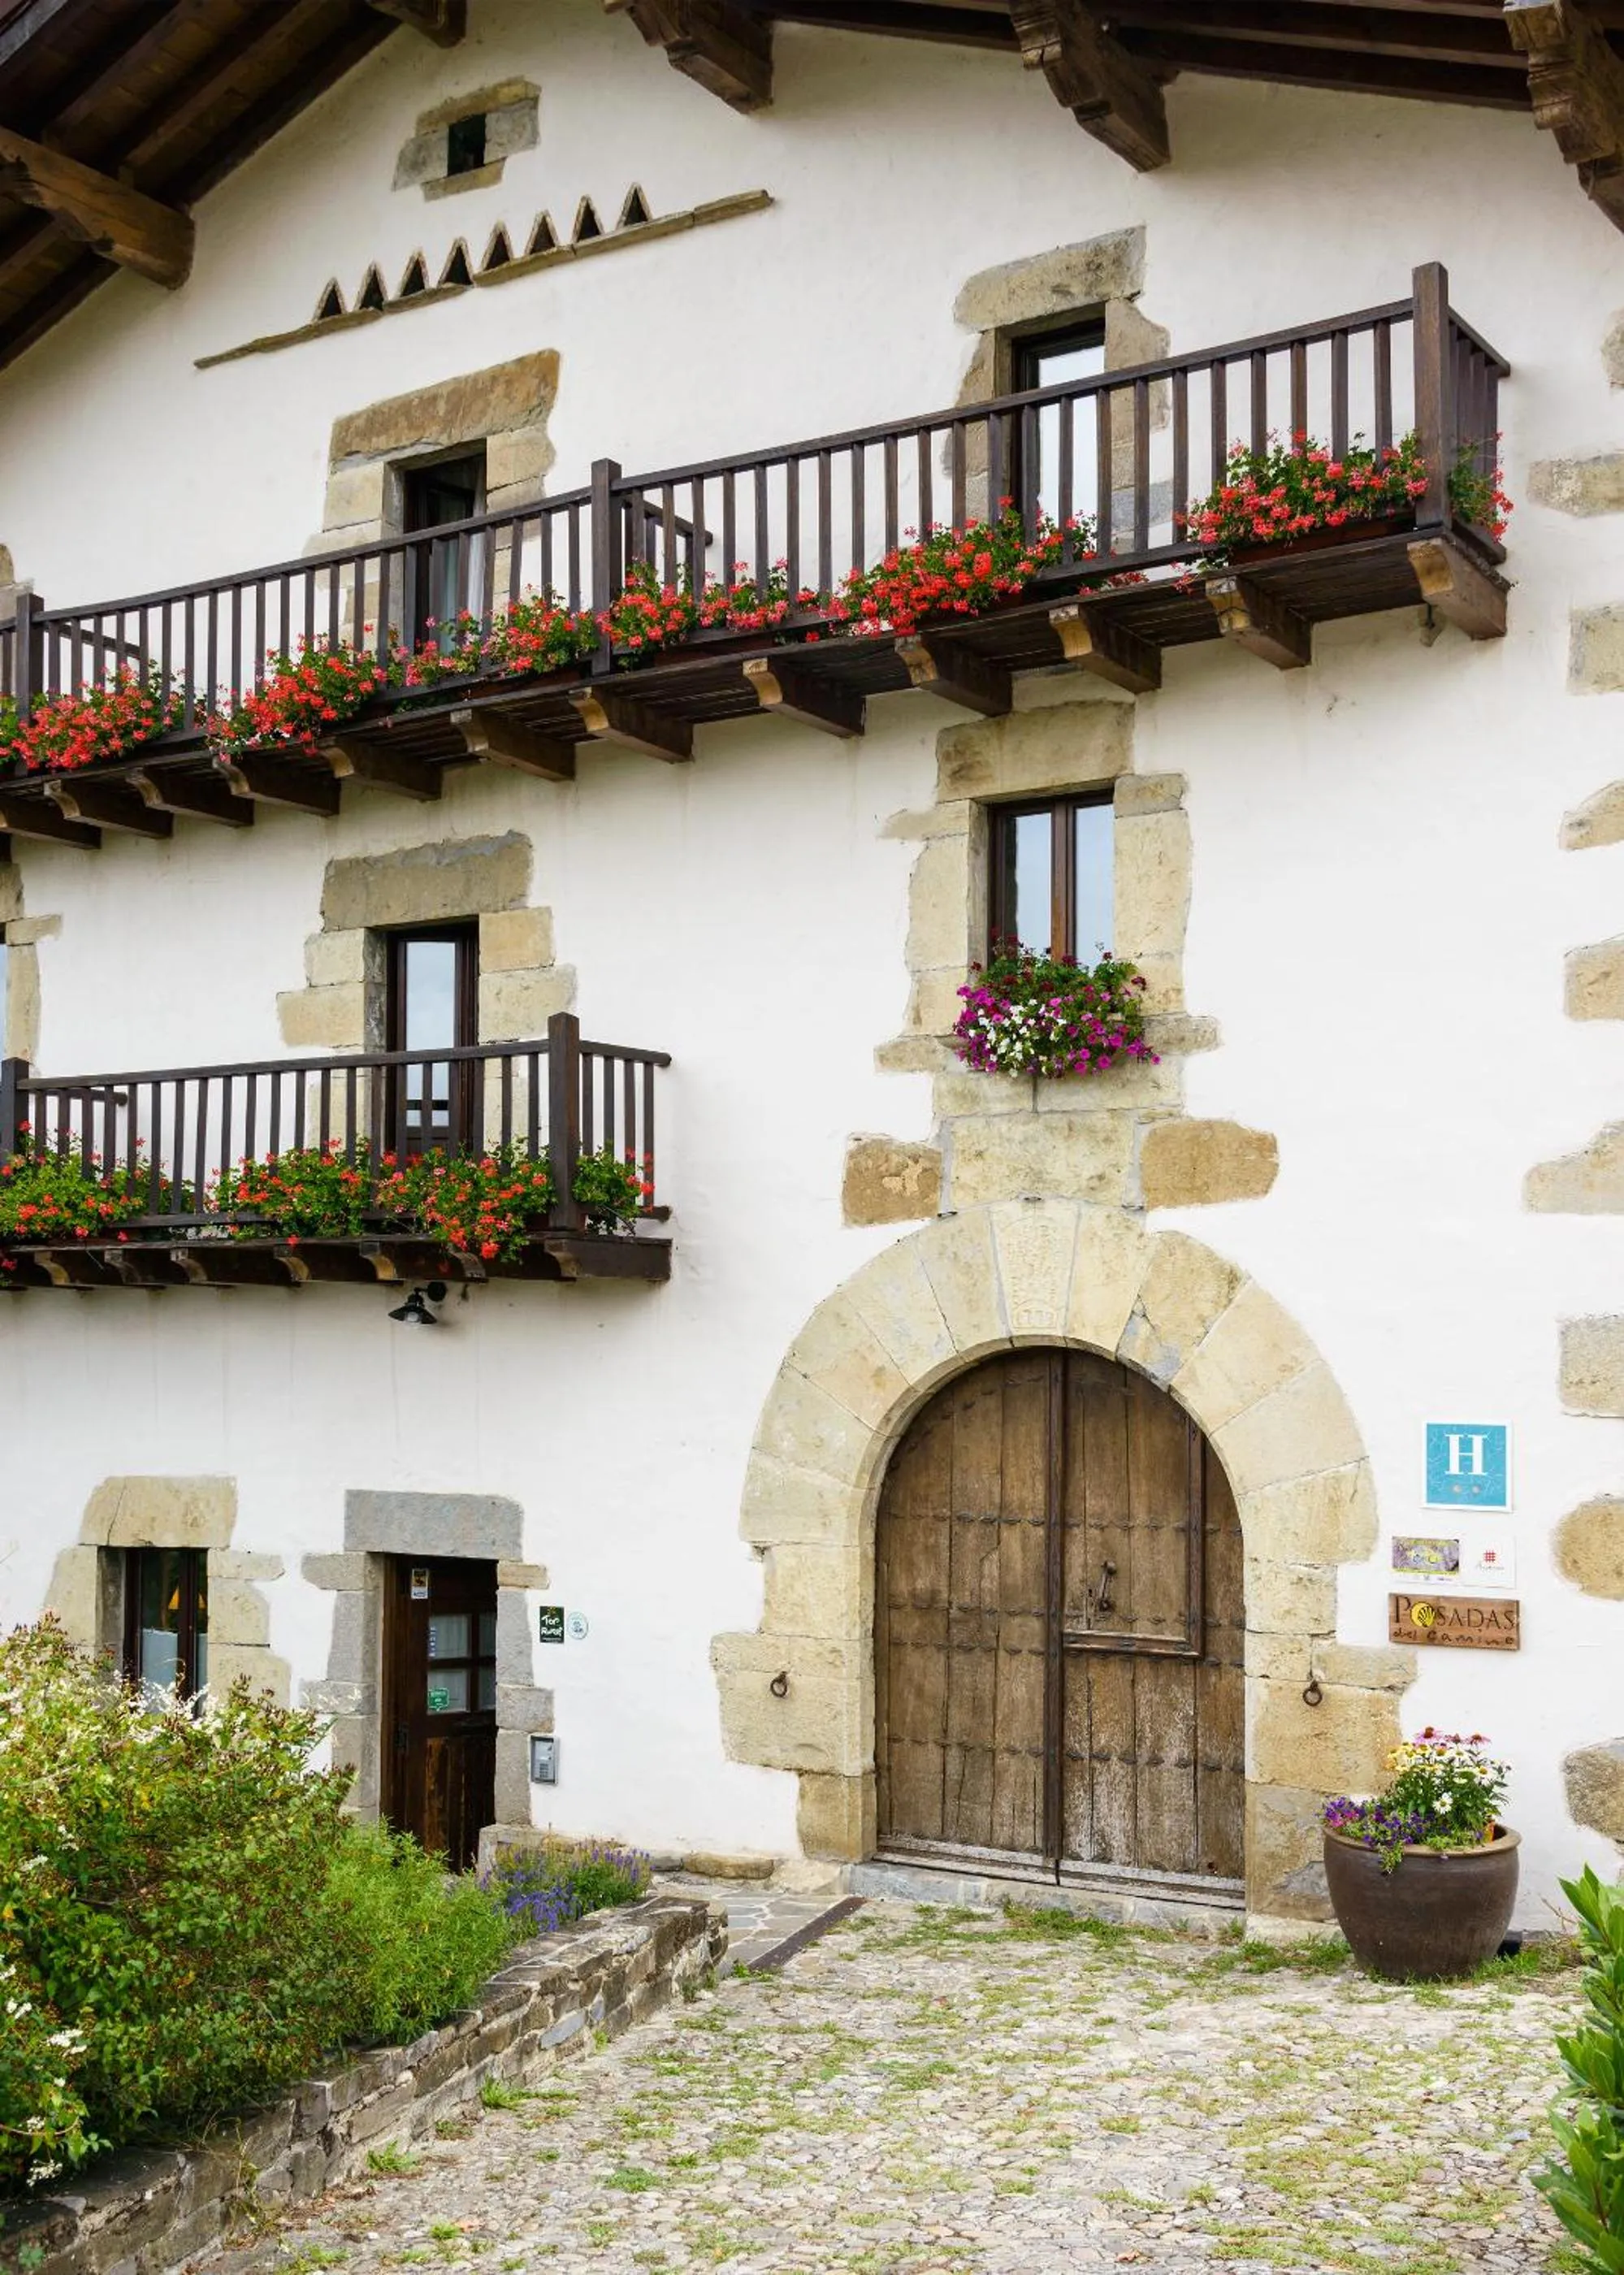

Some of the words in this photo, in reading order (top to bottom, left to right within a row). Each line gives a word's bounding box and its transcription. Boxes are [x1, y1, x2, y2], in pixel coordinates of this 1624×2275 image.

[1444, 1433, 1488, 1476] H
[1393, 1596, 1515, 1630] POSADAS
[1392, 1627, 1417, 1640] del
